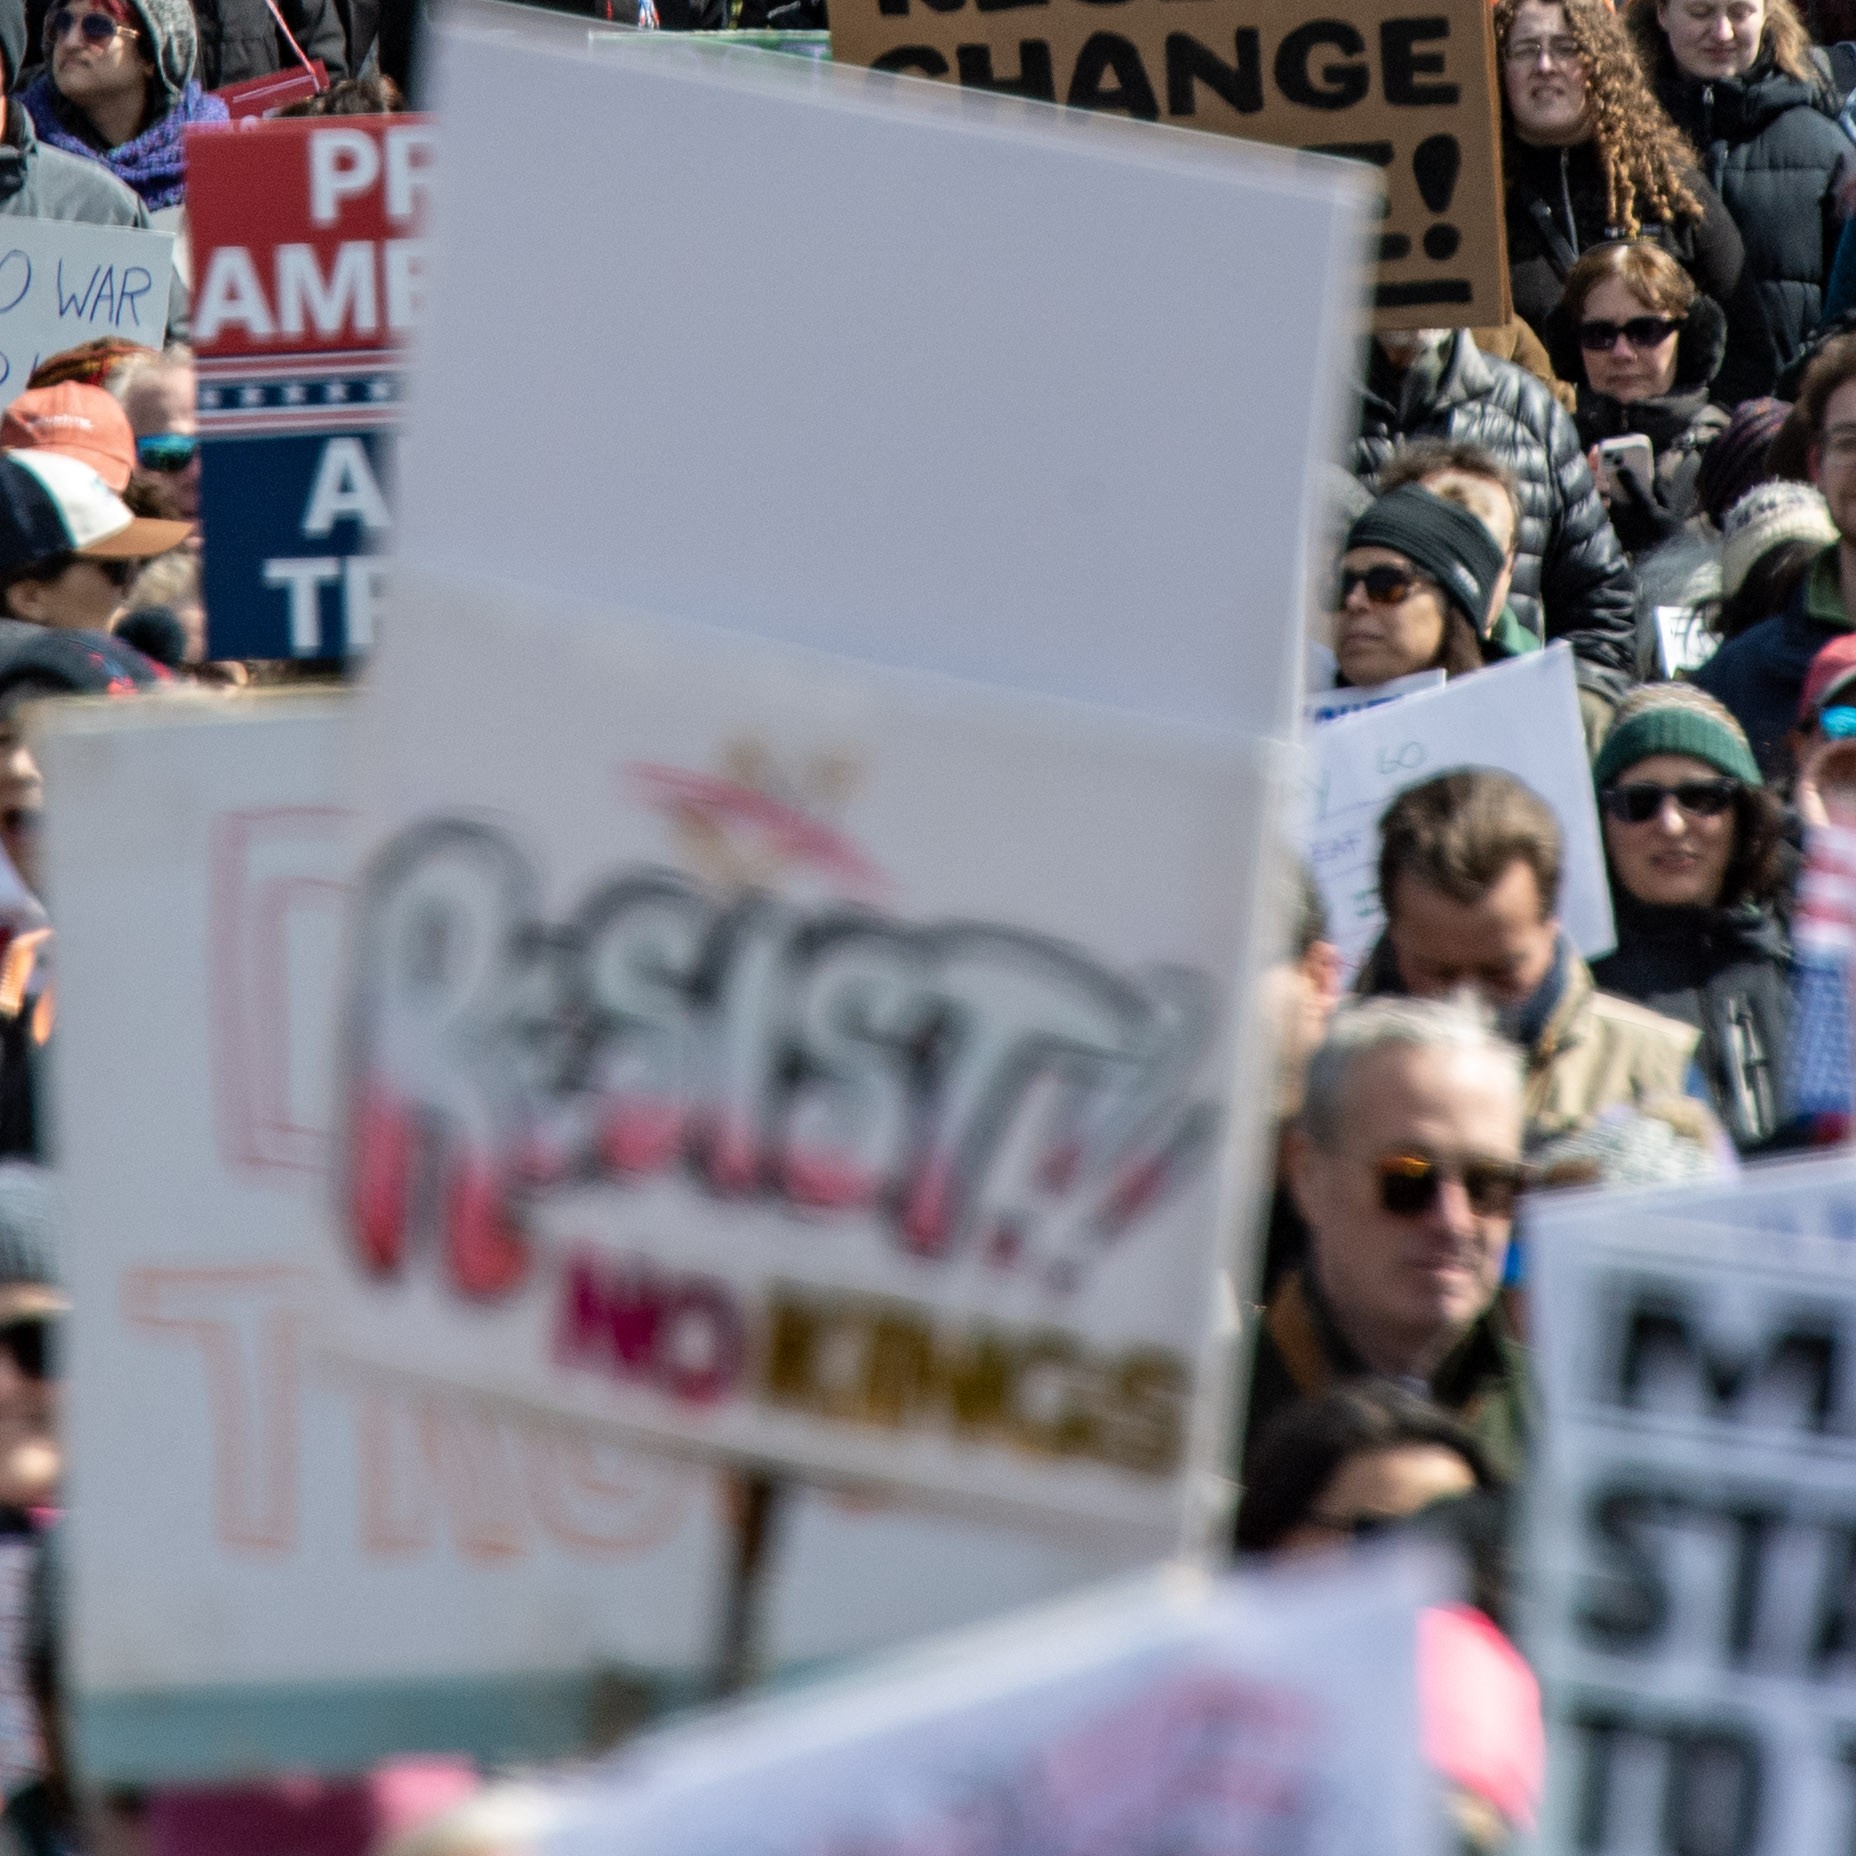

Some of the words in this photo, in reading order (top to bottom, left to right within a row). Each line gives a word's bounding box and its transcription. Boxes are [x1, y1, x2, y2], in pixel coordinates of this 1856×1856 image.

[57, 254, 153, 328] WAR
[554, 1242, 742, 1408] NO
[766, 1280, 1196, 1484] KINGS
